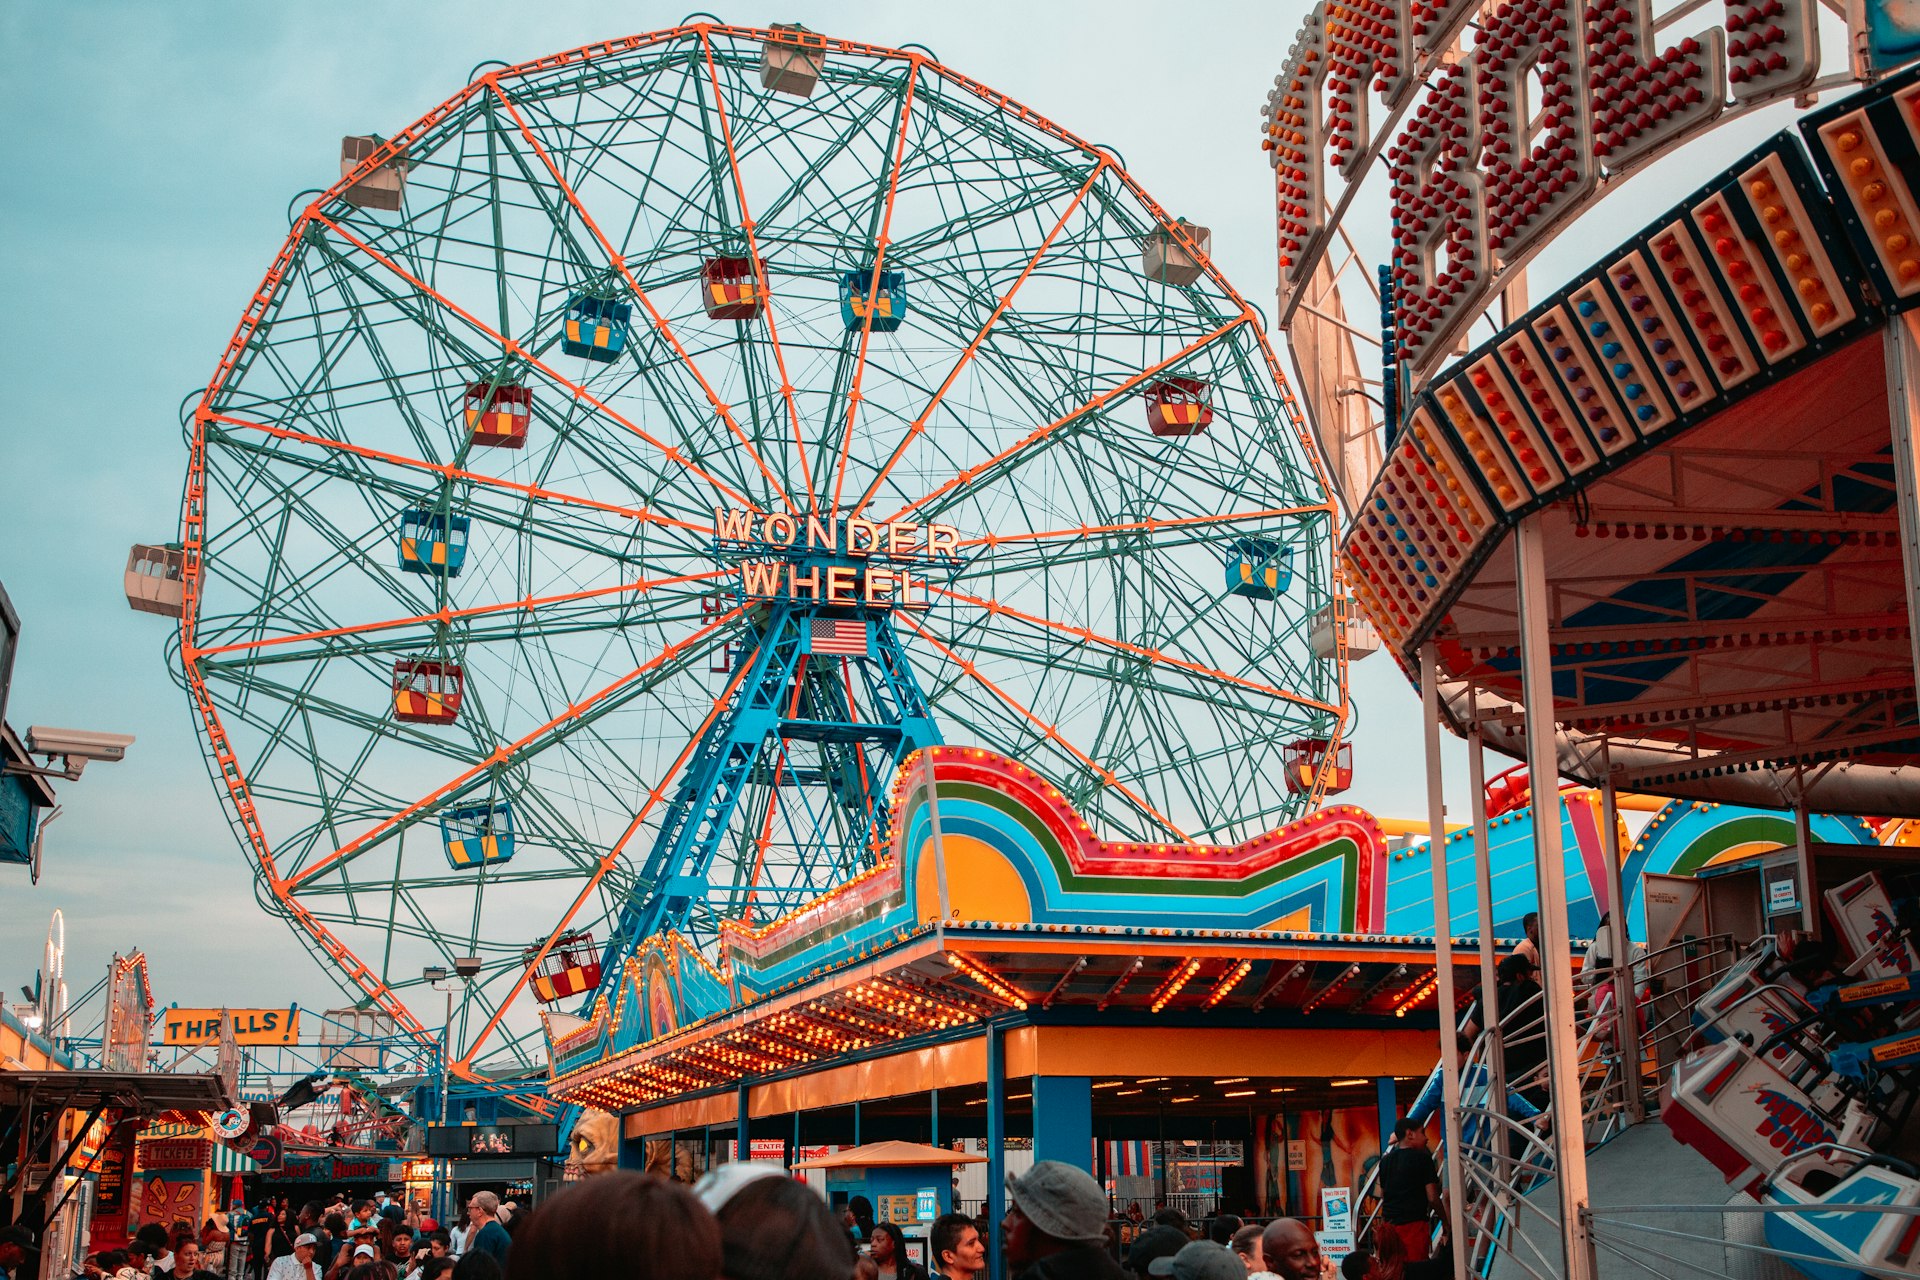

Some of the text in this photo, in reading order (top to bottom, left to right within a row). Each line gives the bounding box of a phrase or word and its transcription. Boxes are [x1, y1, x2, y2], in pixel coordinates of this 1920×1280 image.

[714, 505, 963, 564] WONDER
[741, 559, 931, 610] WHEEL
[168, 1001, 298, 1041] THRLLS!
[213, 1118, 229, 1137] EVERY
[233, 1120, 248, 1137] RACE
[154, 1147, 194, 1160] TICKETS
[331, 1161, 380, 1180] Hunter
